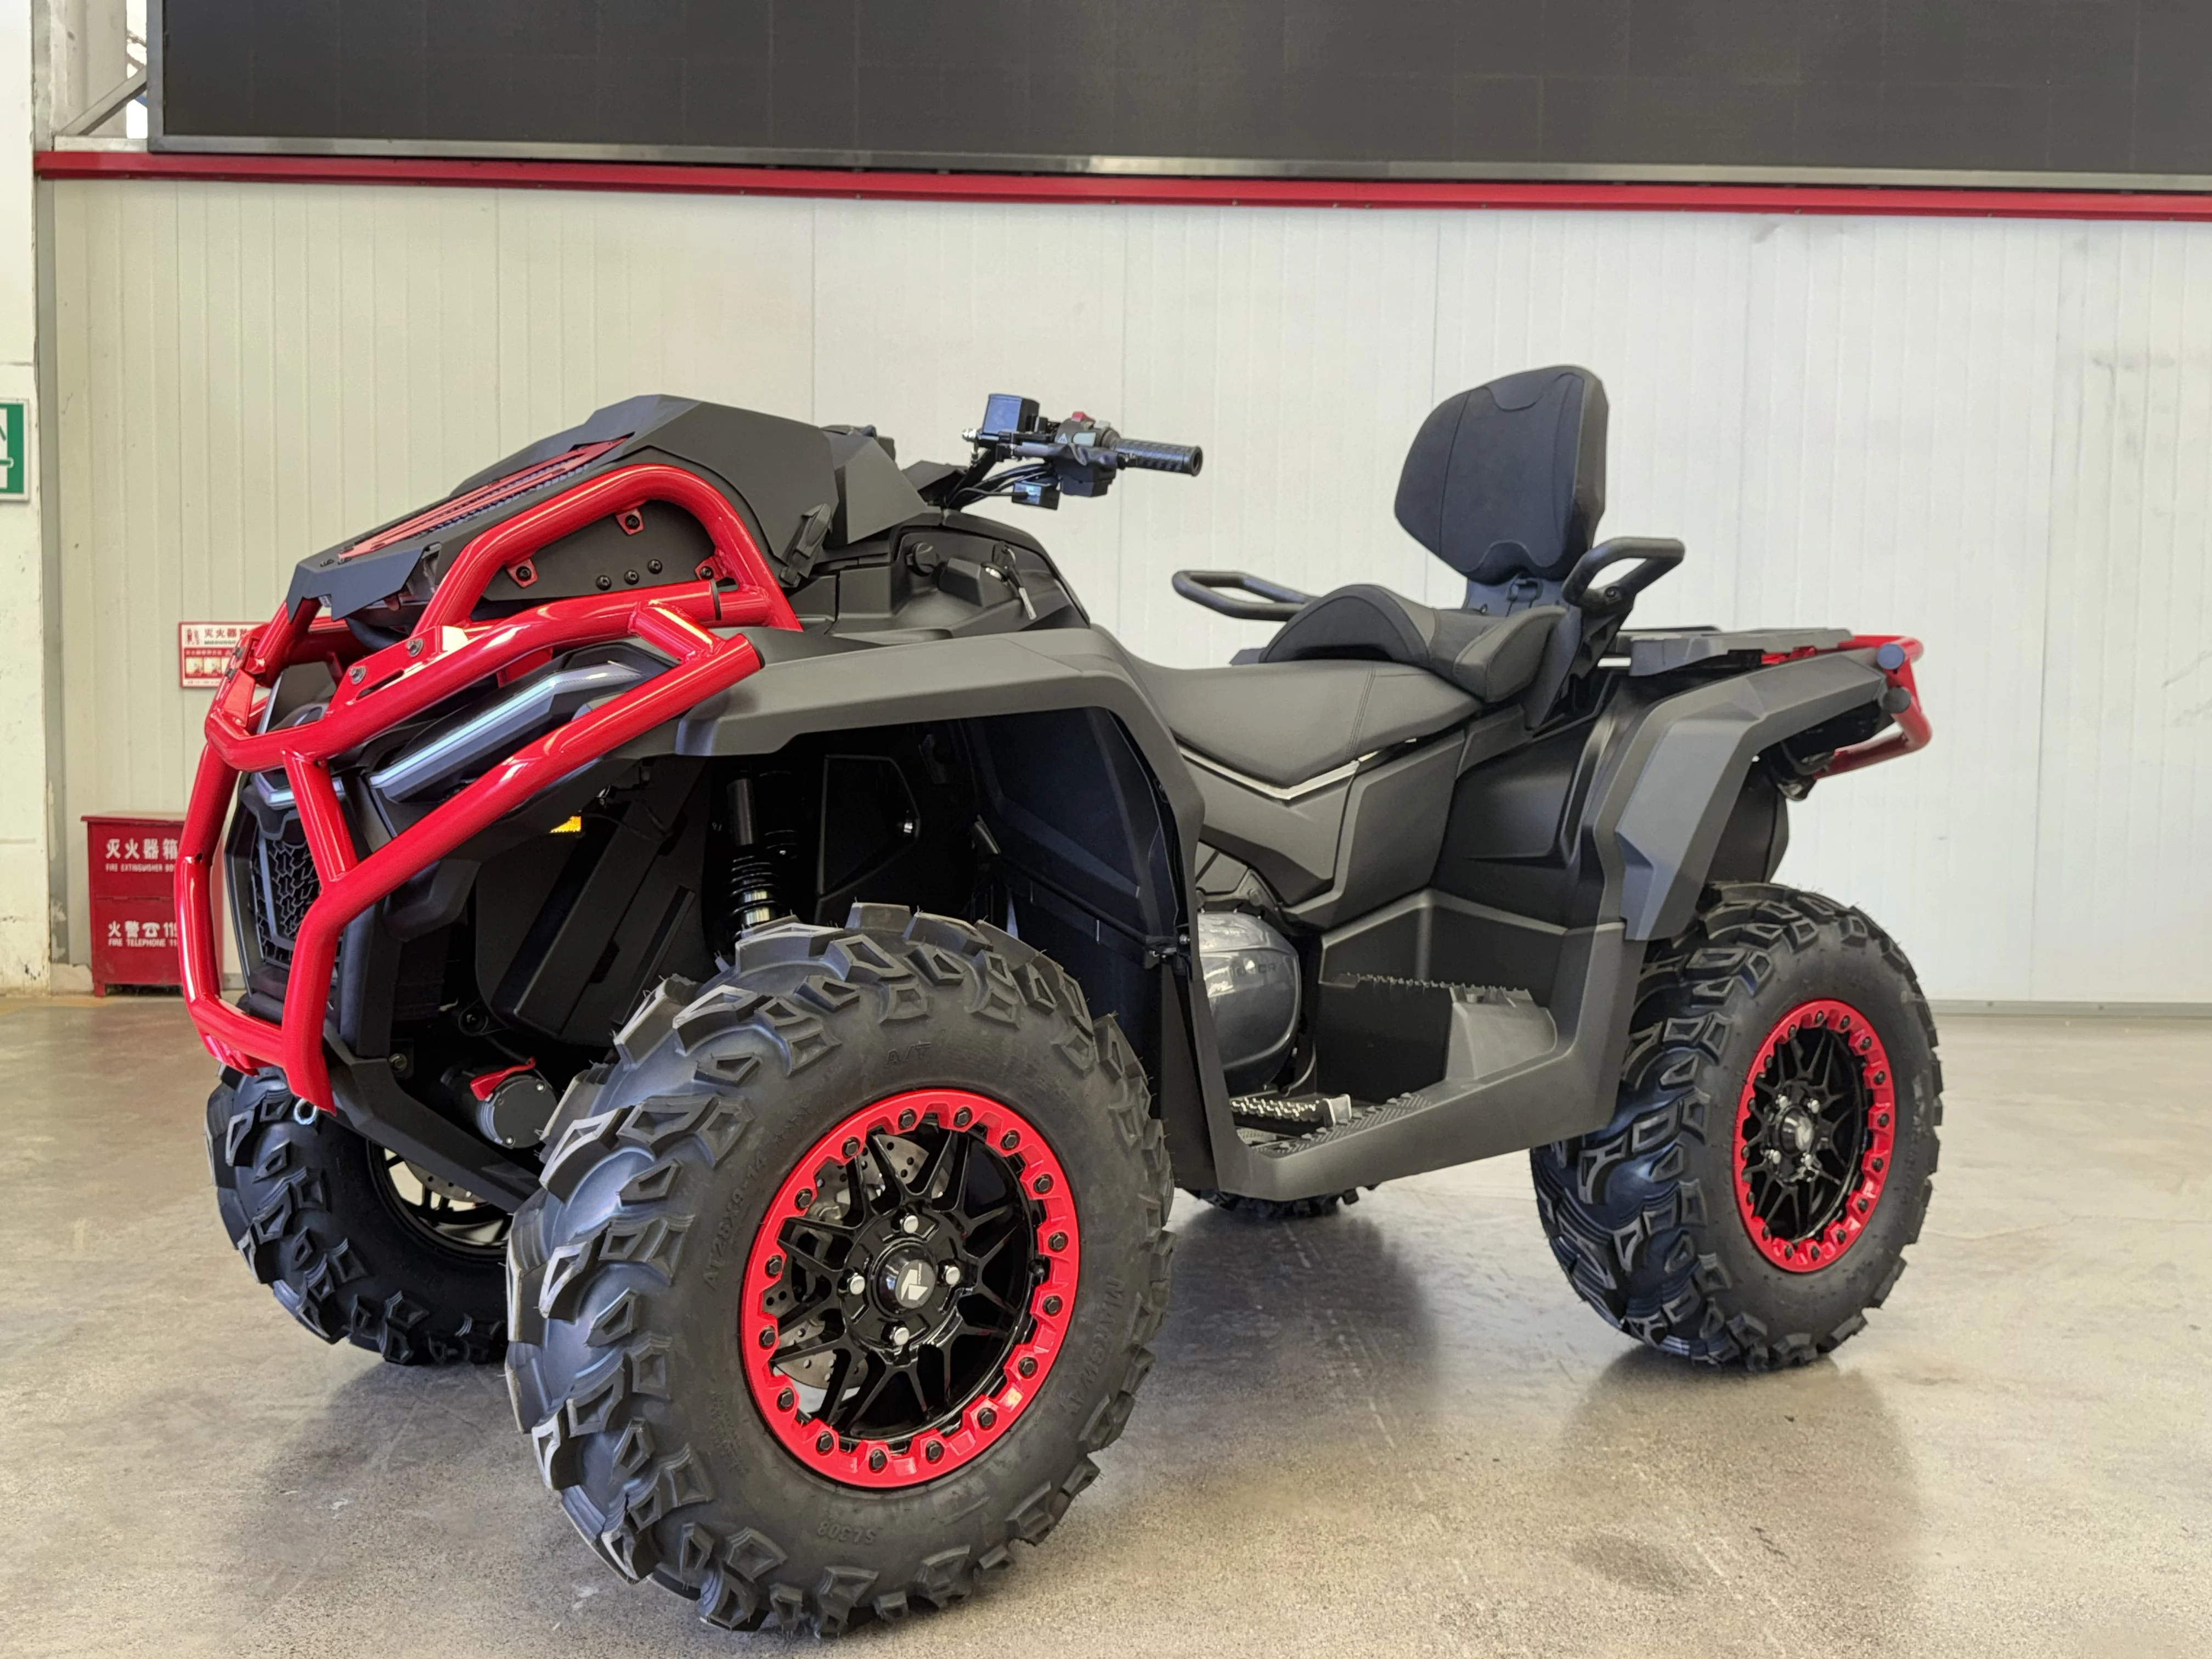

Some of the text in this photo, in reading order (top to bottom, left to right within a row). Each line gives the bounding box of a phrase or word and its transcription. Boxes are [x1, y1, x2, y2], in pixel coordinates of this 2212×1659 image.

[105, 838, 178, 860] 灭火器箱
[106, 863, 174, 872] FIRE EXTINGUISHER BO
[108, 920, 139, 938] 火警
[108, 938, 123, 947] FIRE
[127, 938, 166, 947] TELEPHONE
[816, 1519, 877, 1544] SL308
